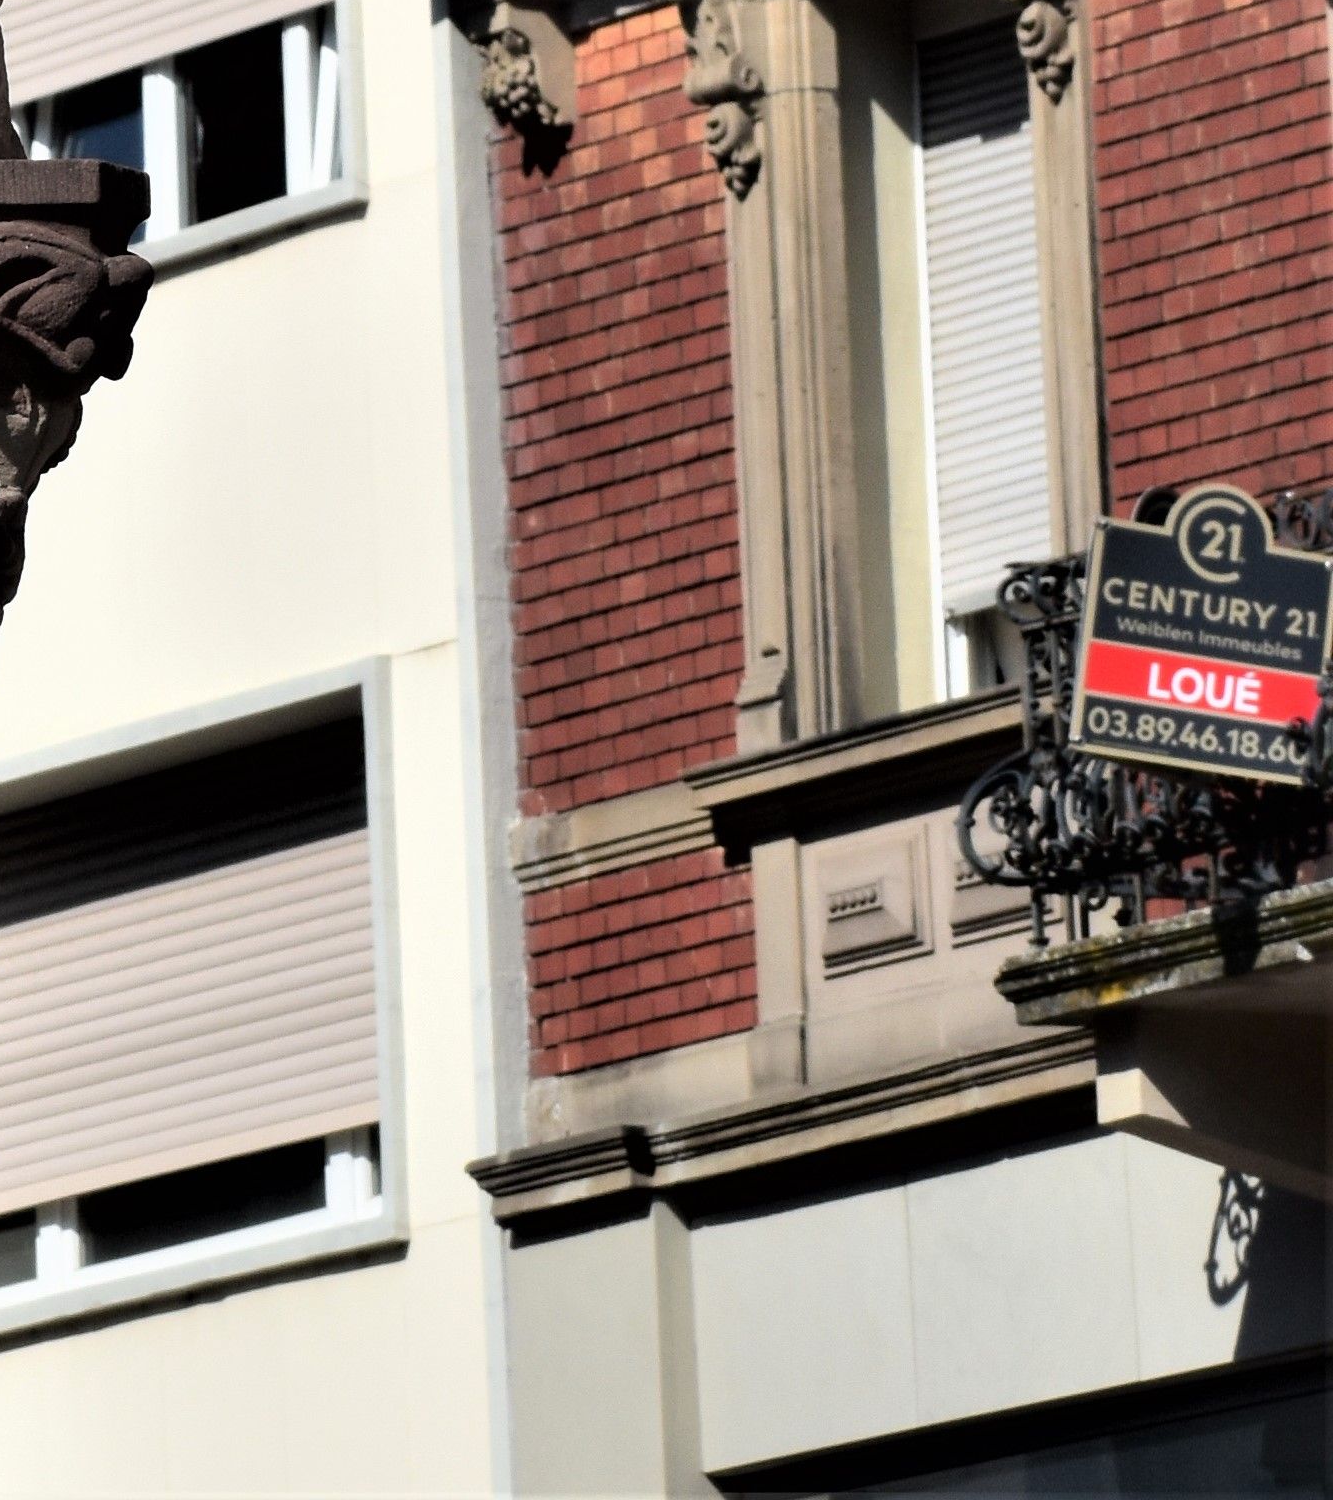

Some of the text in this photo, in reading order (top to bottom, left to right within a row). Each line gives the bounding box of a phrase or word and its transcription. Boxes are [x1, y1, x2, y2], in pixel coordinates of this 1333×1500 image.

[1102, 576, 1319, 638] CENTURY 21
[1116, 615, 1302, 660] Weiblen Immeubles
[1148, 662, 1261, 714] LOUÉ
